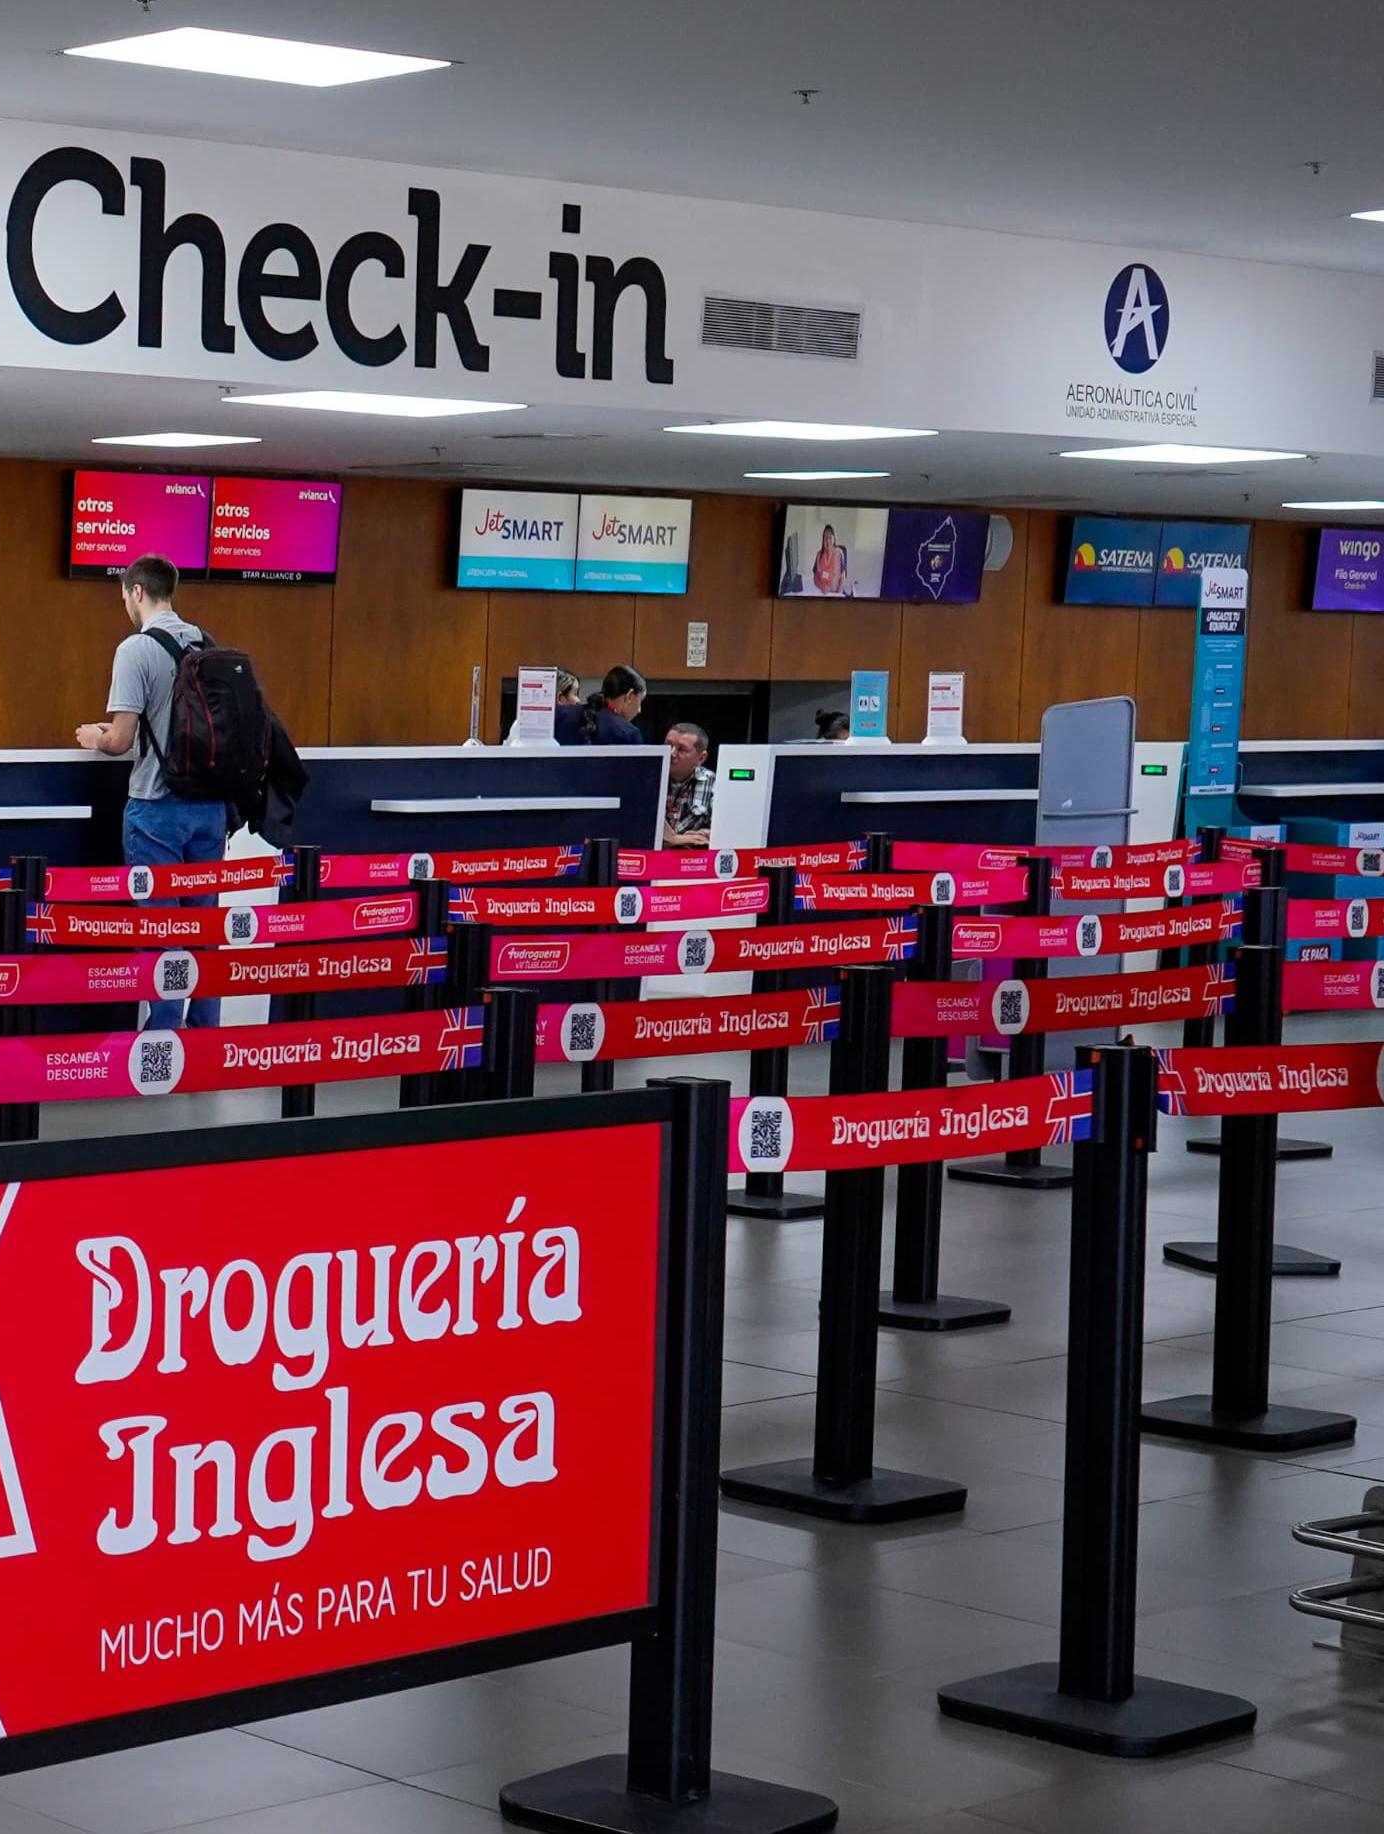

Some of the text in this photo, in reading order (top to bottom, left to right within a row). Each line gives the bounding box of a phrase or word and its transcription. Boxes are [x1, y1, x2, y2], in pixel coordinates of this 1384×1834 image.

[6, 145, 675, 386] Check-in
[1066, 383, 1197, 411] AERONÁUTICA CIVIL
[1066, 405, 1198, 427] UNIDAD ADMINISTRATIVA ESPECIAL
[166, 484, 196, 495] avianca
[299, 490, 328, 501] avianca
[77, 498, 113, 513] otros
[216, 503, 250, 518] otros
[76, 519, 136, 535] servicios
[214, 525, 270, 540] servicios
[475, 508, 564, 542] JetSMART
[592, 513, 677, 547] JetSMART
[76, 541, 127, 552] other services
[214, 547, 261, 557] other services
[1339, 540, 1380, 561] wingo
[1098, 548, 1153, 568] SATENA
[1187, 552, 1241, 570] SATENA
[242, 570, 293, 580] STAR ALLIANCE
[1205, 580, 1244, 600] JetSMART
[503, 856, 548, 873] Inglesa
[800, 853, 840, 868] Inglesa
[220, 867, 264, 884] Inglesa
[872, 883, 913, 900] Inglesa
[486, 897, 596, 916] Droguería Inglesa
[68, 914, 201, 937] Droguería Inglesa
[1169, 917, 1212, 938] Inglesa
[624, 944, 660, 954] ESCANEA
[738, 934, 872, 961] Droguería Inglesa
[624, 955, 665, 965] DESCUBRE
[88, 967, 139, 977] ESCANEA Y
[229, 956, 392, 983] Droguería Inglesa
[88, 978, 138, 989] DESCUBRE
[936, 998, 972, 1008] ESCANEA
[1055, 987, 1192, 1017] Droguería Inglesa
[937, 1010, 979, 1021] DESCUBRE
[634, 1010, 790, 1042] Droguería Inglesa
[46, 1051, 111, 1065] ESCANEA Y
[223, 1031, 421, 1070] Droguería Inglesa
[46, 1066, 109, 1081] DESCUBRE
[1194, 1062, 1350, 1098] Droguería Inglesa
[831, 1103, 1030, 1149] Droguería Inglesa
[73, 1195, 583, 1393] Droguería
[95, 1385, 559, 1563] Inglesa
[100, 1546, 553, 1674] MUCHO MÁS PARA TU SALUD
